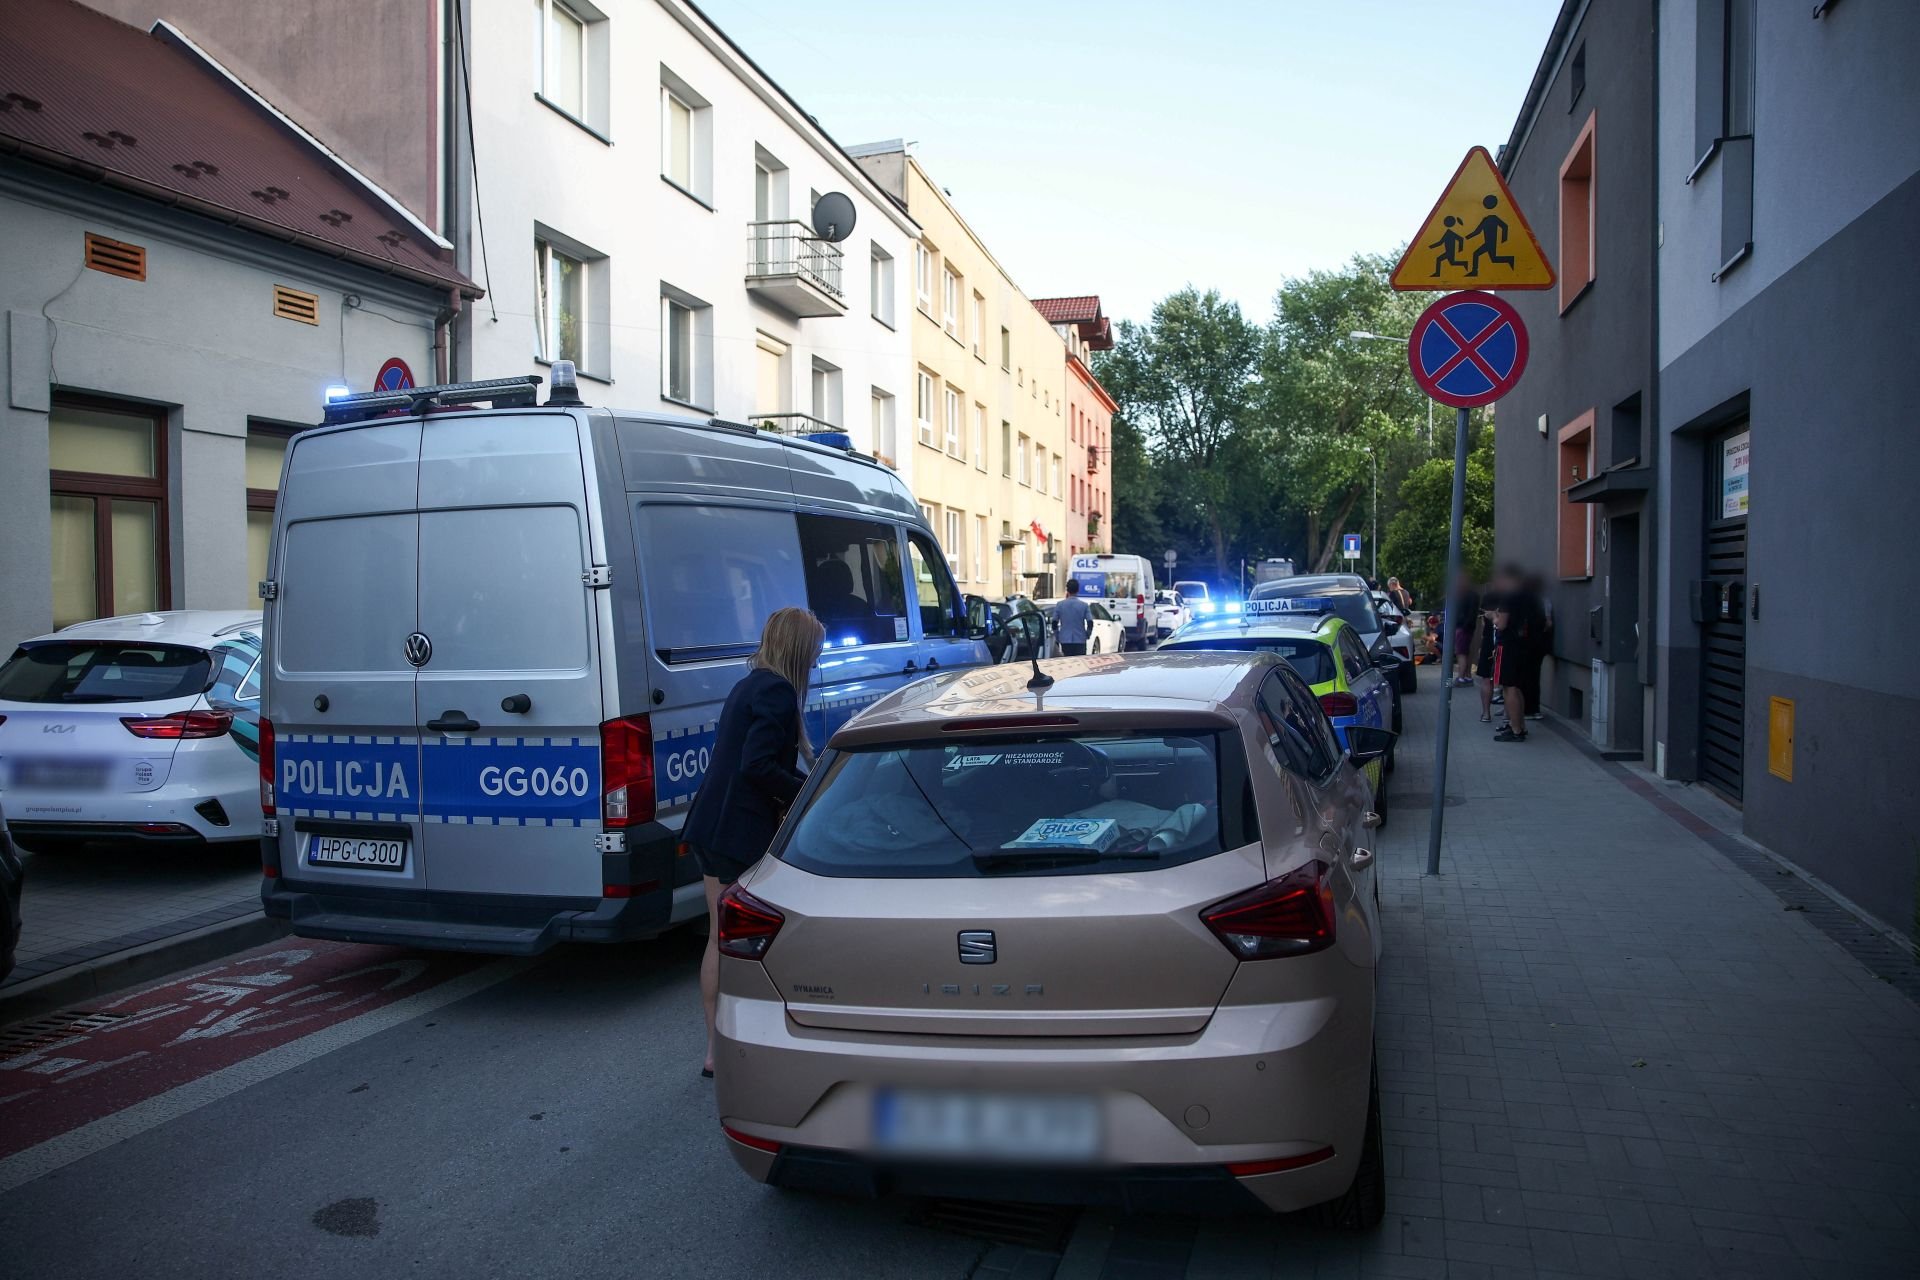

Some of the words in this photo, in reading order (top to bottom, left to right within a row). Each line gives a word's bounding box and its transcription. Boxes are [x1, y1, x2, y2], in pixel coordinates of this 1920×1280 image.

[1601, 517, 1607, 553] 8
[1076, 559, 1099, 569] GLS
[1244, 601, 1289, 612] POLICJA
[945, 754, 962, 770] 4
[283, 759, 410, 799] POLICJA
[479, 766, 589, 798] GG060
[1042, 822, 1090, 834] Blue
[320, 839, 352, 860] HPG
[357, 842, 399, 864] C300
[793, 984, 834, 994] DYNAMICA
[922, 983, 1044, 996] IBIZA
